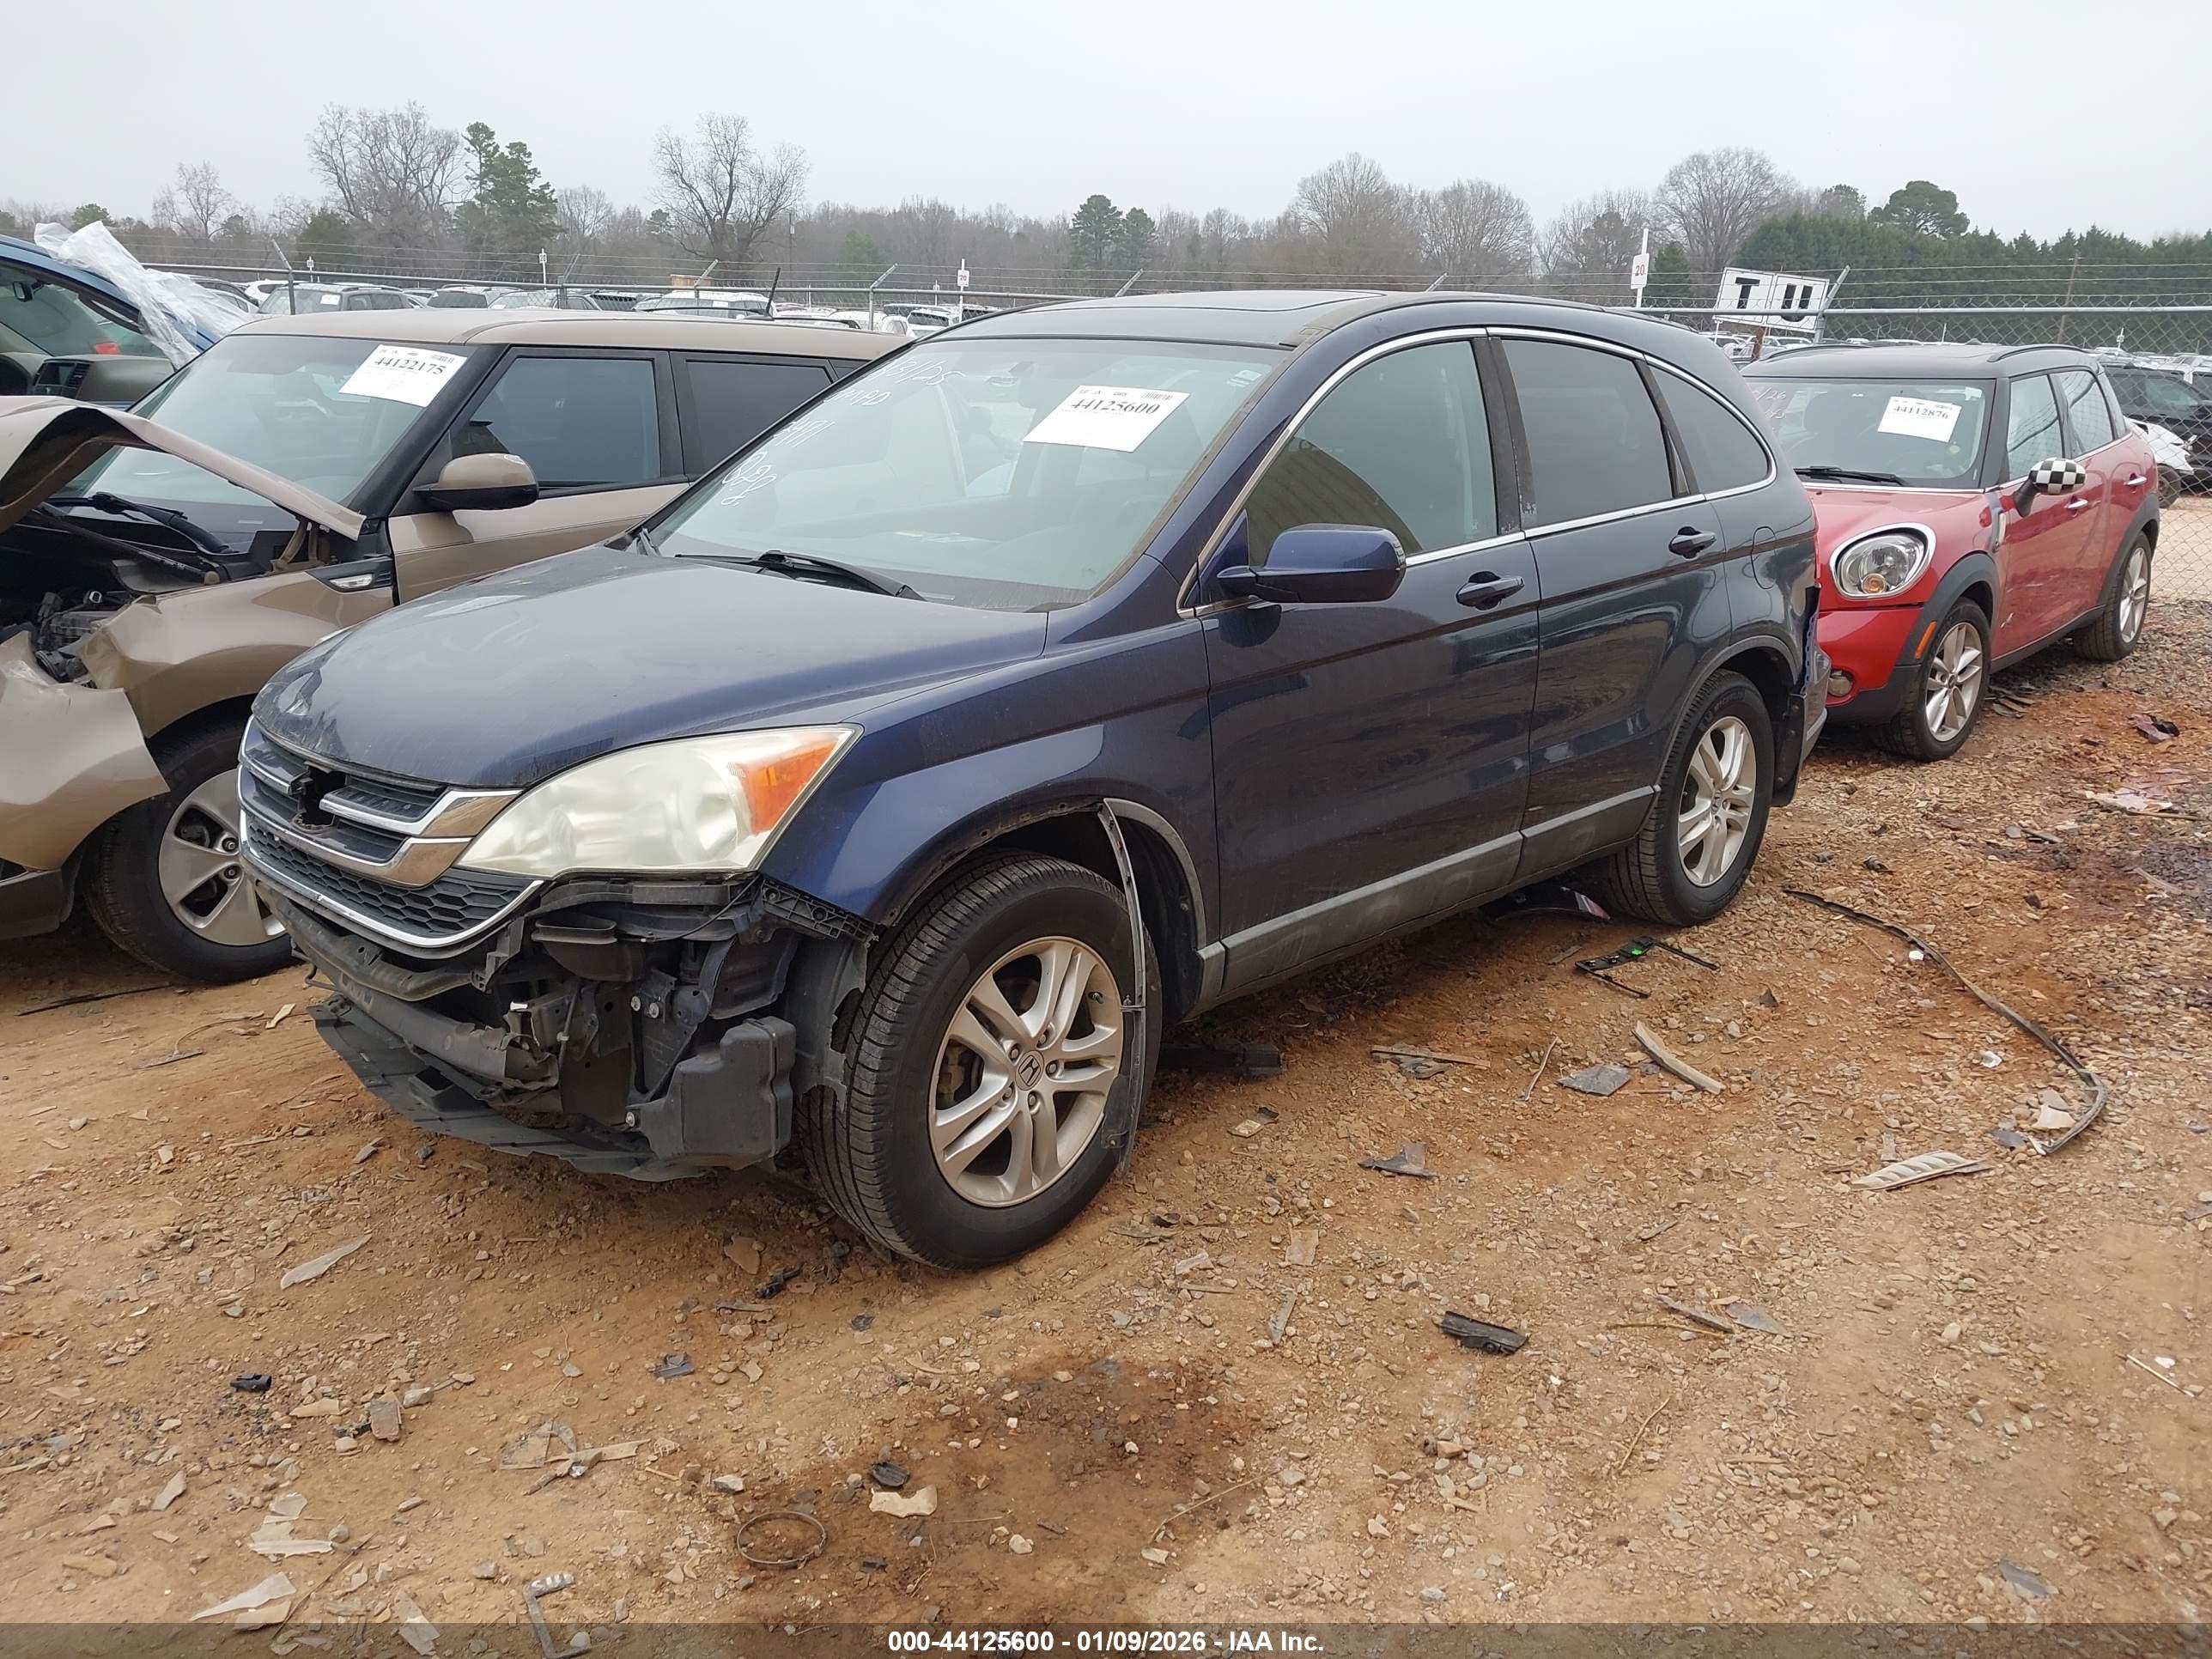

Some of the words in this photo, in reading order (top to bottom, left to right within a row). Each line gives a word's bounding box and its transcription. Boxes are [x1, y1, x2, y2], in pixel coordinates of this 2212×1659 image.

[1635, 264, 1644, 276] 20
[374, 356, 447, 375] 44122175
[1072, 398, 1161, 415] 44125600
[1893, 405, 1949, 420] 44112876
